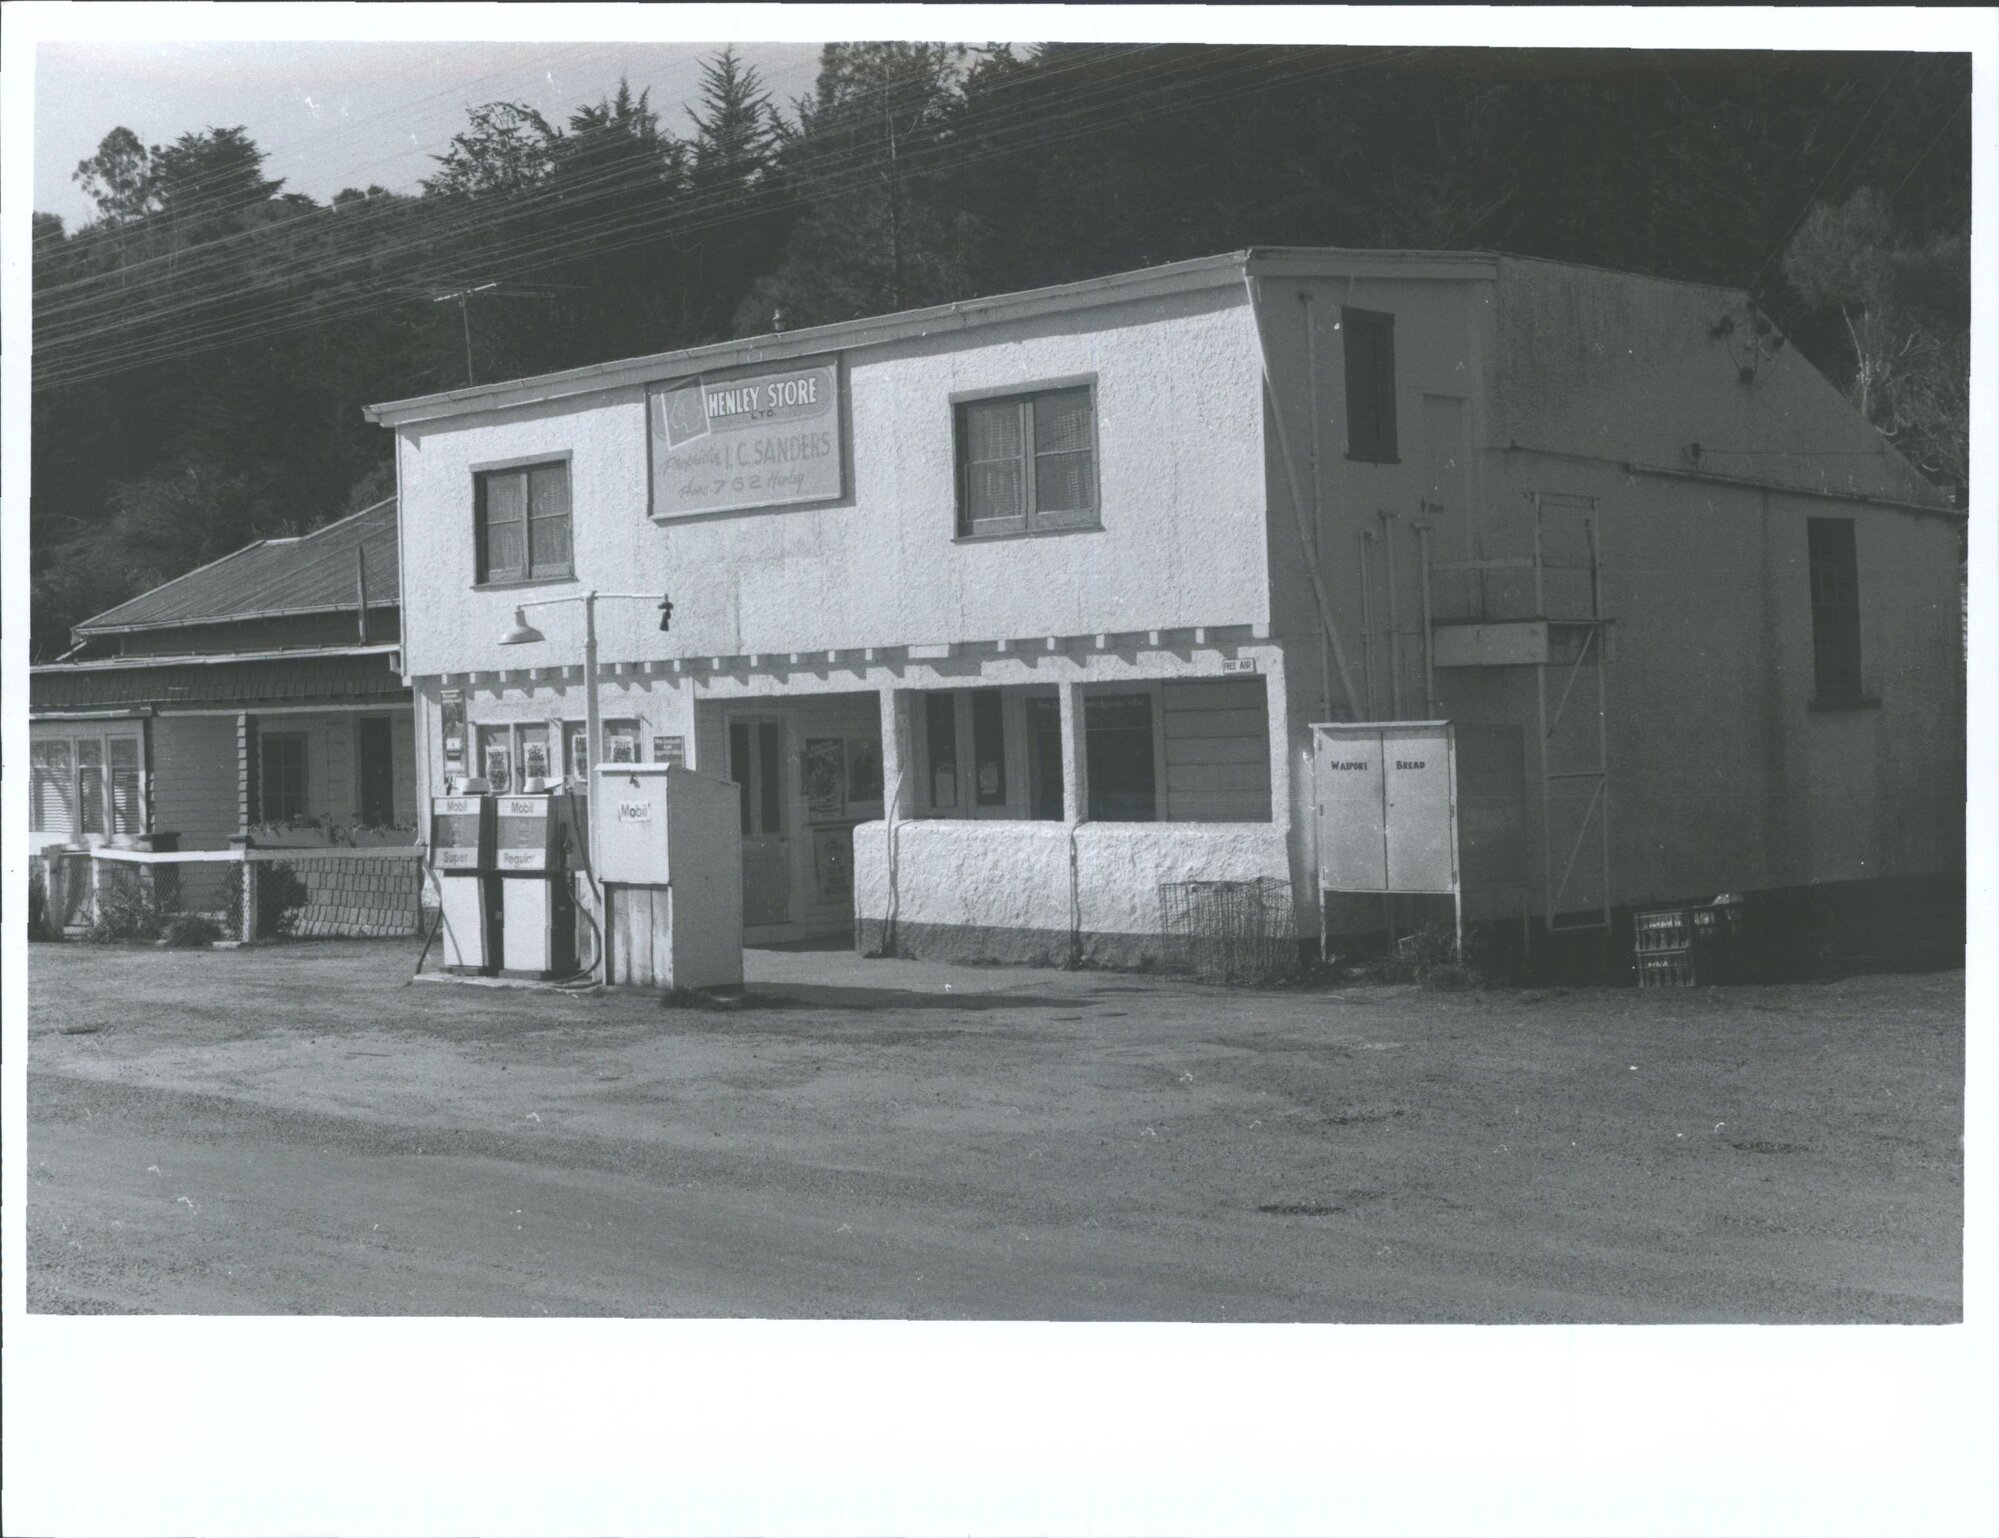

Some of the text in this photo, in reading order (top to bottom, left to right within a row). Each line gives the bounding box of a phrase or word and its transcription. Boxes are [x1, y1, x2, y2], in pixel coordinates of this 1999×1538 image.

[708, 378, 816, 417] HENLEY STORE
[754, 431, 831, 465] SANDERS
[1223, 660, 1251, 670] FREE AIR
[1331, 760, 1425, 771] WAIPORI BREAD
[447, 800, 468, 812] Mobil
[511, 802, 534, 814] Mobil
[621, 804, 647, 818] Mobil
[443, 851, 468, 866] Super
[504, 852, 535, 868] Regular
